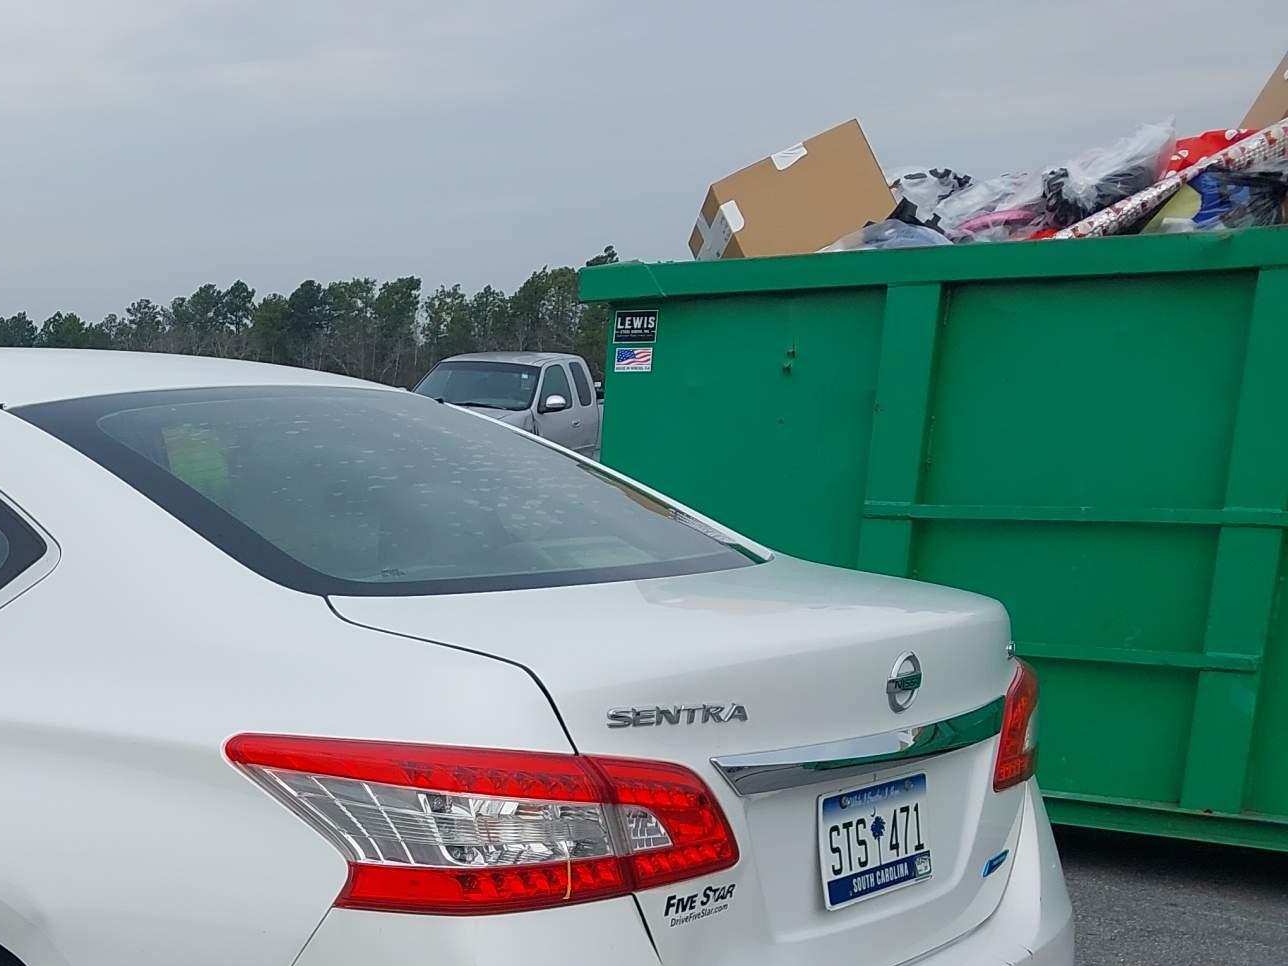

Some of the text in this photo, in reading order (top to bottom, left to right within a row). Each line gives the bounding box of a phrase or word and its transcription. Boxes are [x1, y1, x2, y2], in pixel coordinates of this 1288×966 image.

[617, 316, 656, 329] LEWIS
[894, 678, 921, 689] NISS
[607, 703, 748, 728] SENTRA
[829, 802, 924, 876] STS 471
[852, 871, 875, 893] SOUTH
[876, 862, 909, 886] CAROLINA
[663, 883, 736, 917] FIVE STAR
[670, 903, 728, 927] DriveFiveStar.com
